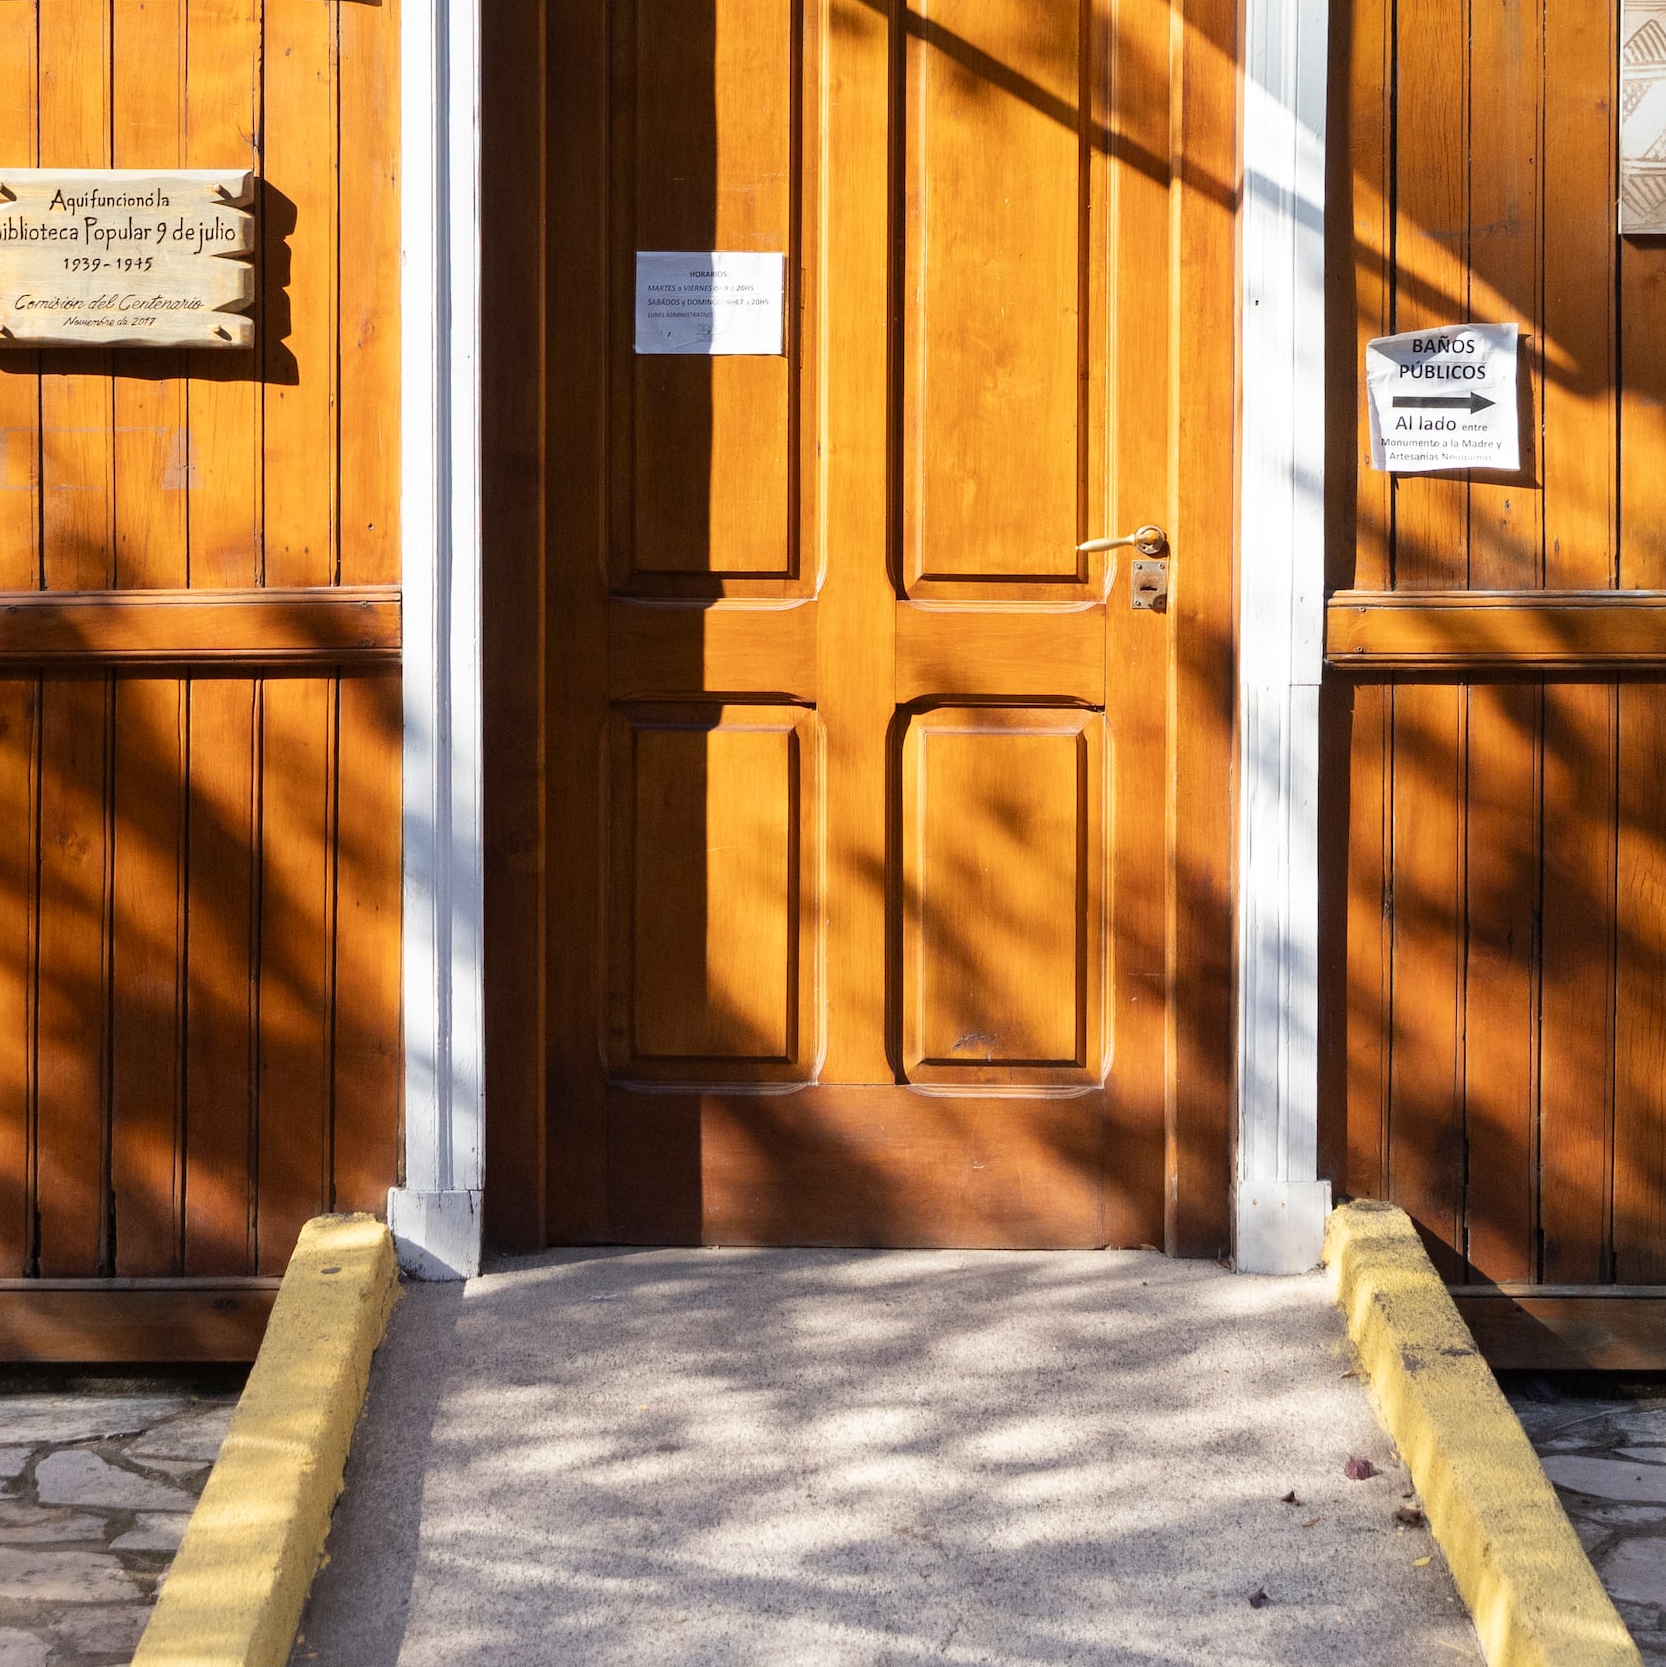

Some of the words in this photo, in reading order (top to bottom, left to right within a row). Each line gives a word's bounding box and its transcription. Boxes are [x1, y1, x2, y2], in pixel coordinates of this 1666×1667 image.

[49, 189, 89, 216] Aquí
[91, 188, 153, 207] funcionó
[157, 188, 169, 207] la
[84, 217, 151, 250] Popular
[156, 222, 167, 244] 9
[172, 218, 195, 241] de
[194, 217, 235, 255] julio
[15, 294, 84, 311] Comisión
[88, 294, 116, 310] del
[118, 295, 205, 310] Centenario
[63, 317, 114, 326] Noviembre
[117, 317, 128, 326] de
[131, 317, 156, 326] 2017
[1413, 336, 1475, 353] BAÑOS
[1399, 361, 1486, 379] PÚBLICOS
[1395, 416, 1412, 430] Al
[1419, 416, 1456, 431] lado
[1462, 424, 1487, 432] entre
[1381, 439, 1439, 447] Monumento
[1450, 439, 1459, 448] la
[1462, 440, 1493, 448] Madre
[1496, 441, 1501, 449] y
